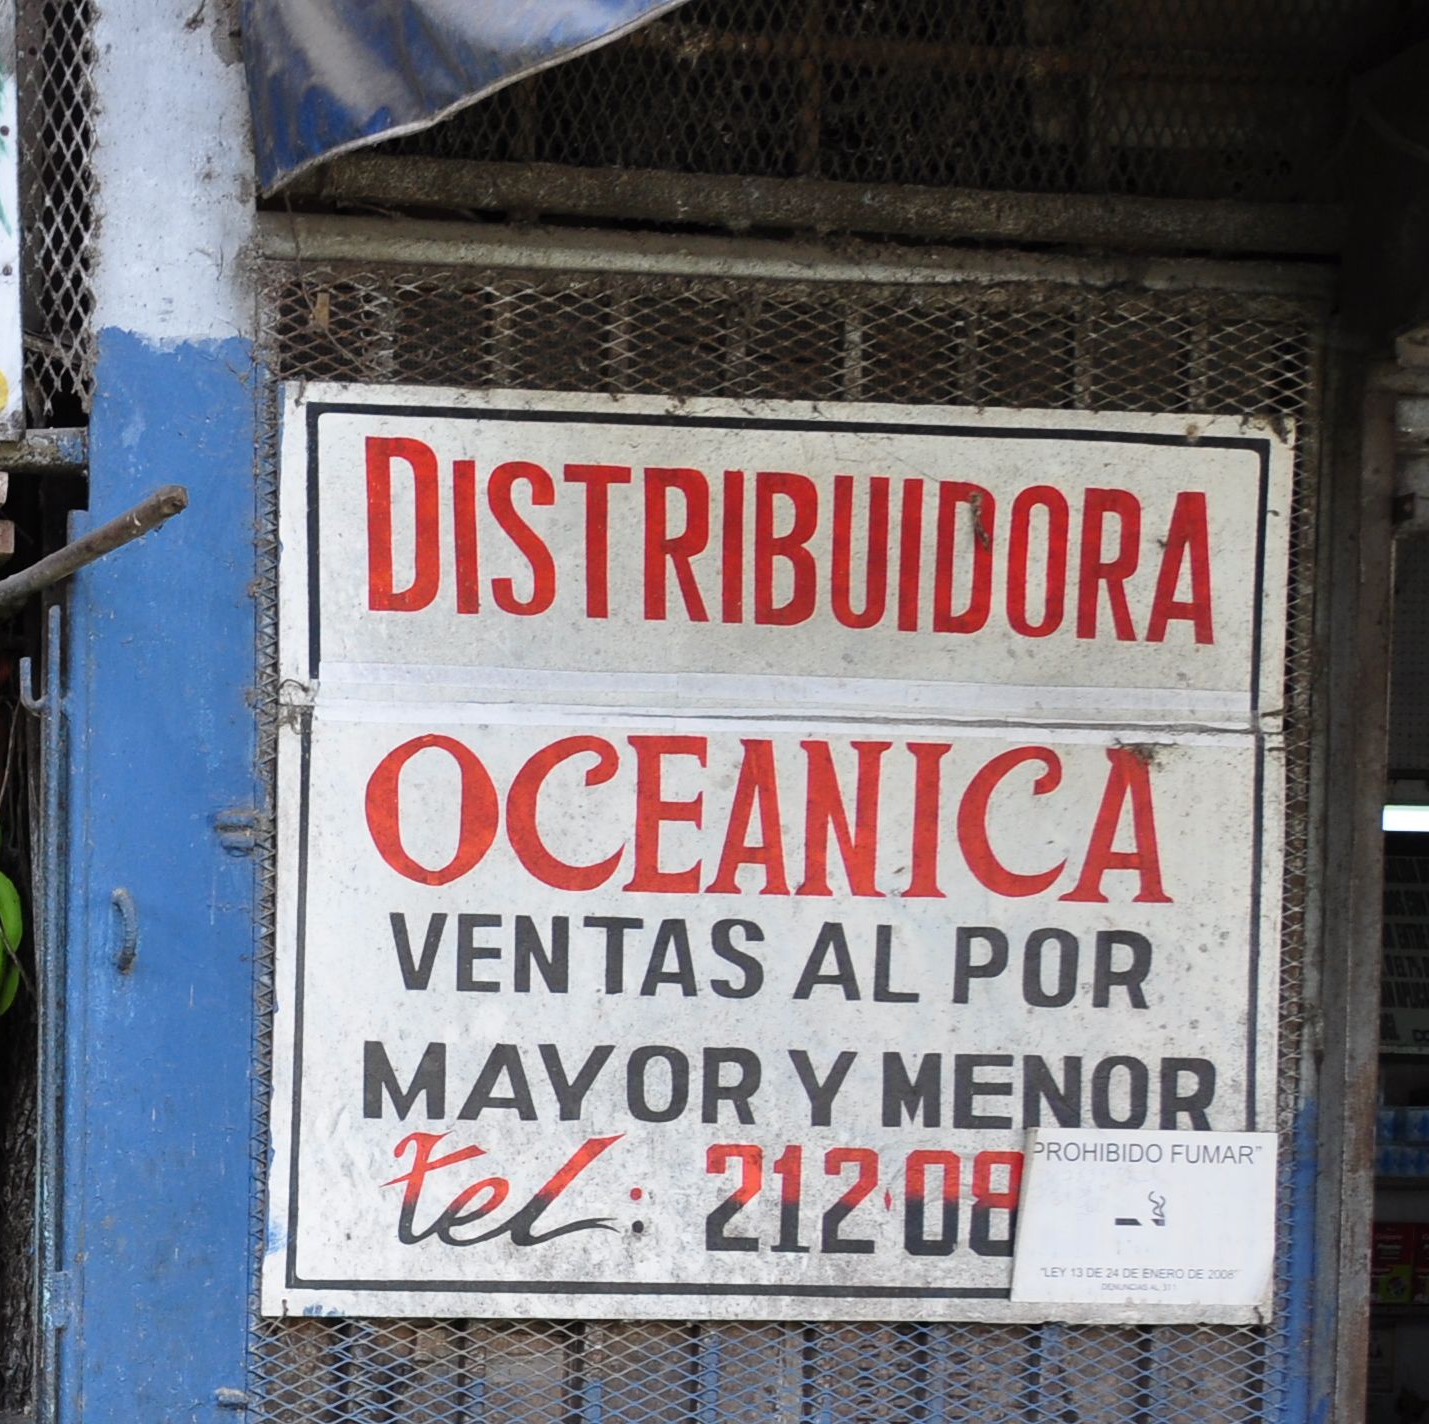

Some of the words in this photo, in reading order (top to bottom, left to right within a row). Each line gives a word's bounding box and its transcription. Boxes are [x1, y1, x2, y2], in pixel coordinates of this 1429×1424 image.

[364, 435, 1216, 646] DISTRIBUIDORA
[363, 733, 1174, 905] OCEANICA
[389, 912, 765, 997] VENTAS
[793, 921, 919, 1003] AL
[952, 925, 1153, 1010] POR
[362, 1040, 763, 1126] MAYOR
[786, 1049, 857, 1129] Y
[881, 1052, 1217, 1131] MENOR
[1033, 1142, 1164, 1164] PROHIBIDO
[1071, 1268, 1084, 1278] 13
[1086, 1268, 1102, 1279] DE
[1105, 1269, 1120, 1279] 24
[1122, 1269, 1139, 1279] DE
[1142, 1269, 1184, 1280] ENERO
[1188, 1269, 1204, 1280] DE
